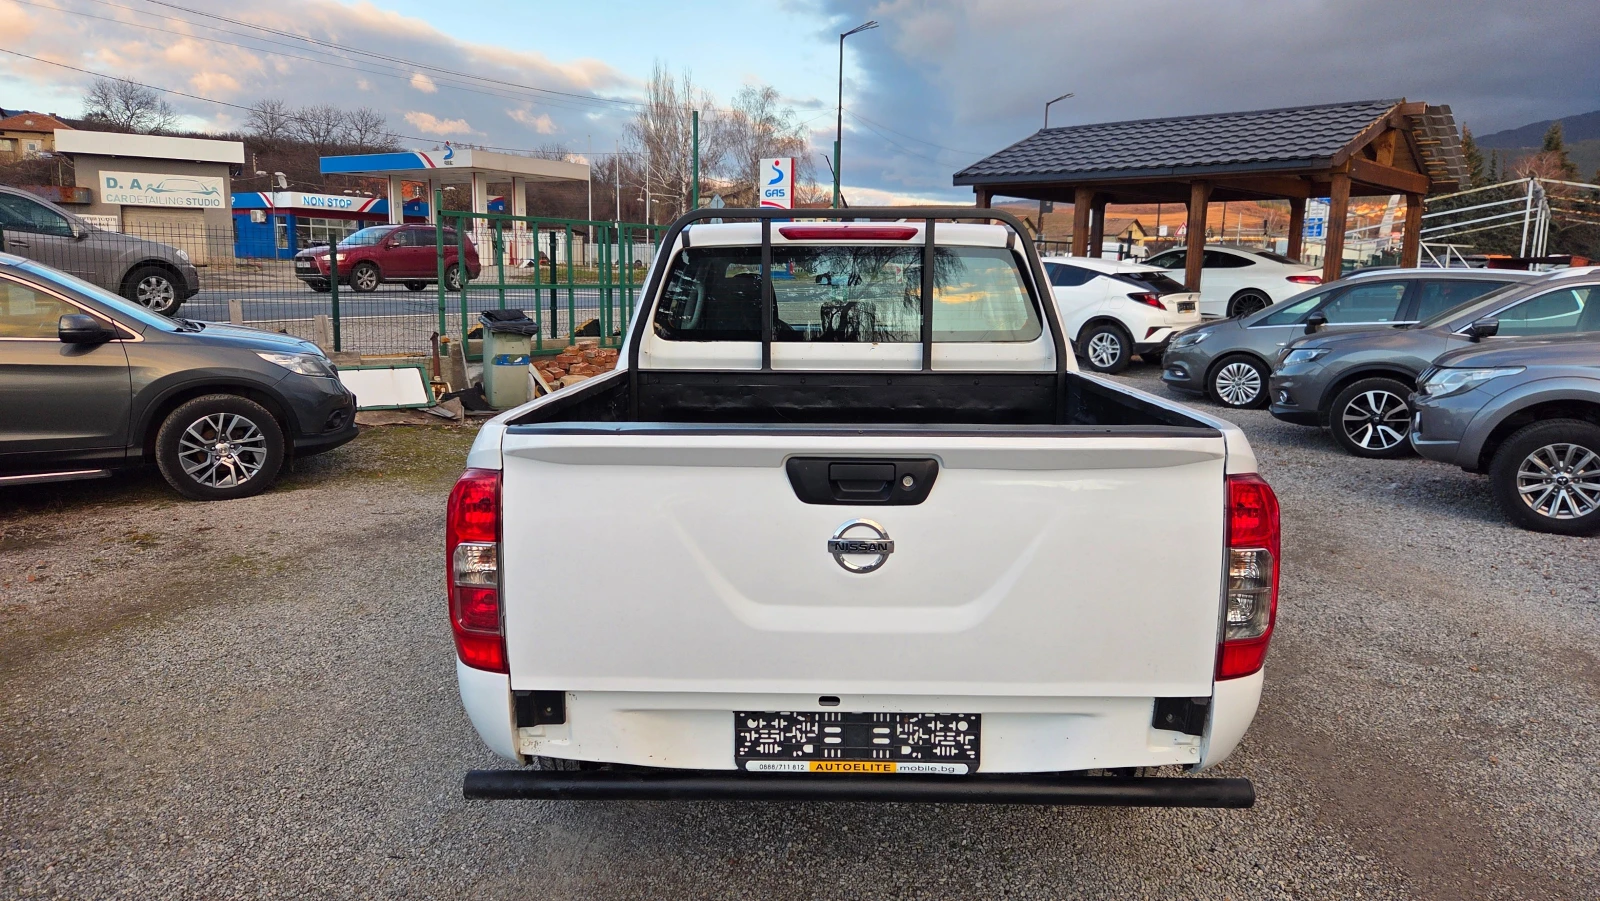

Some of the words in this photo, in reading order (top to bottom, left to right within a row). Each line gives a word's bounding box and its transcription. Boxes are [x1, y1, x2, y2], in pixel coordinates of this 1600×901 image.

[130, 178, 142, 189] A
[765, 188, 785, 198] GAS
[185, 197, 220, 207] STUDIO
[303, 196, 324, 206] NON
[327, 198, 352, 208] STOP
[835, 543, 888, 551] NISSAN
[815, 763, 891, 772] AUTOELITE
